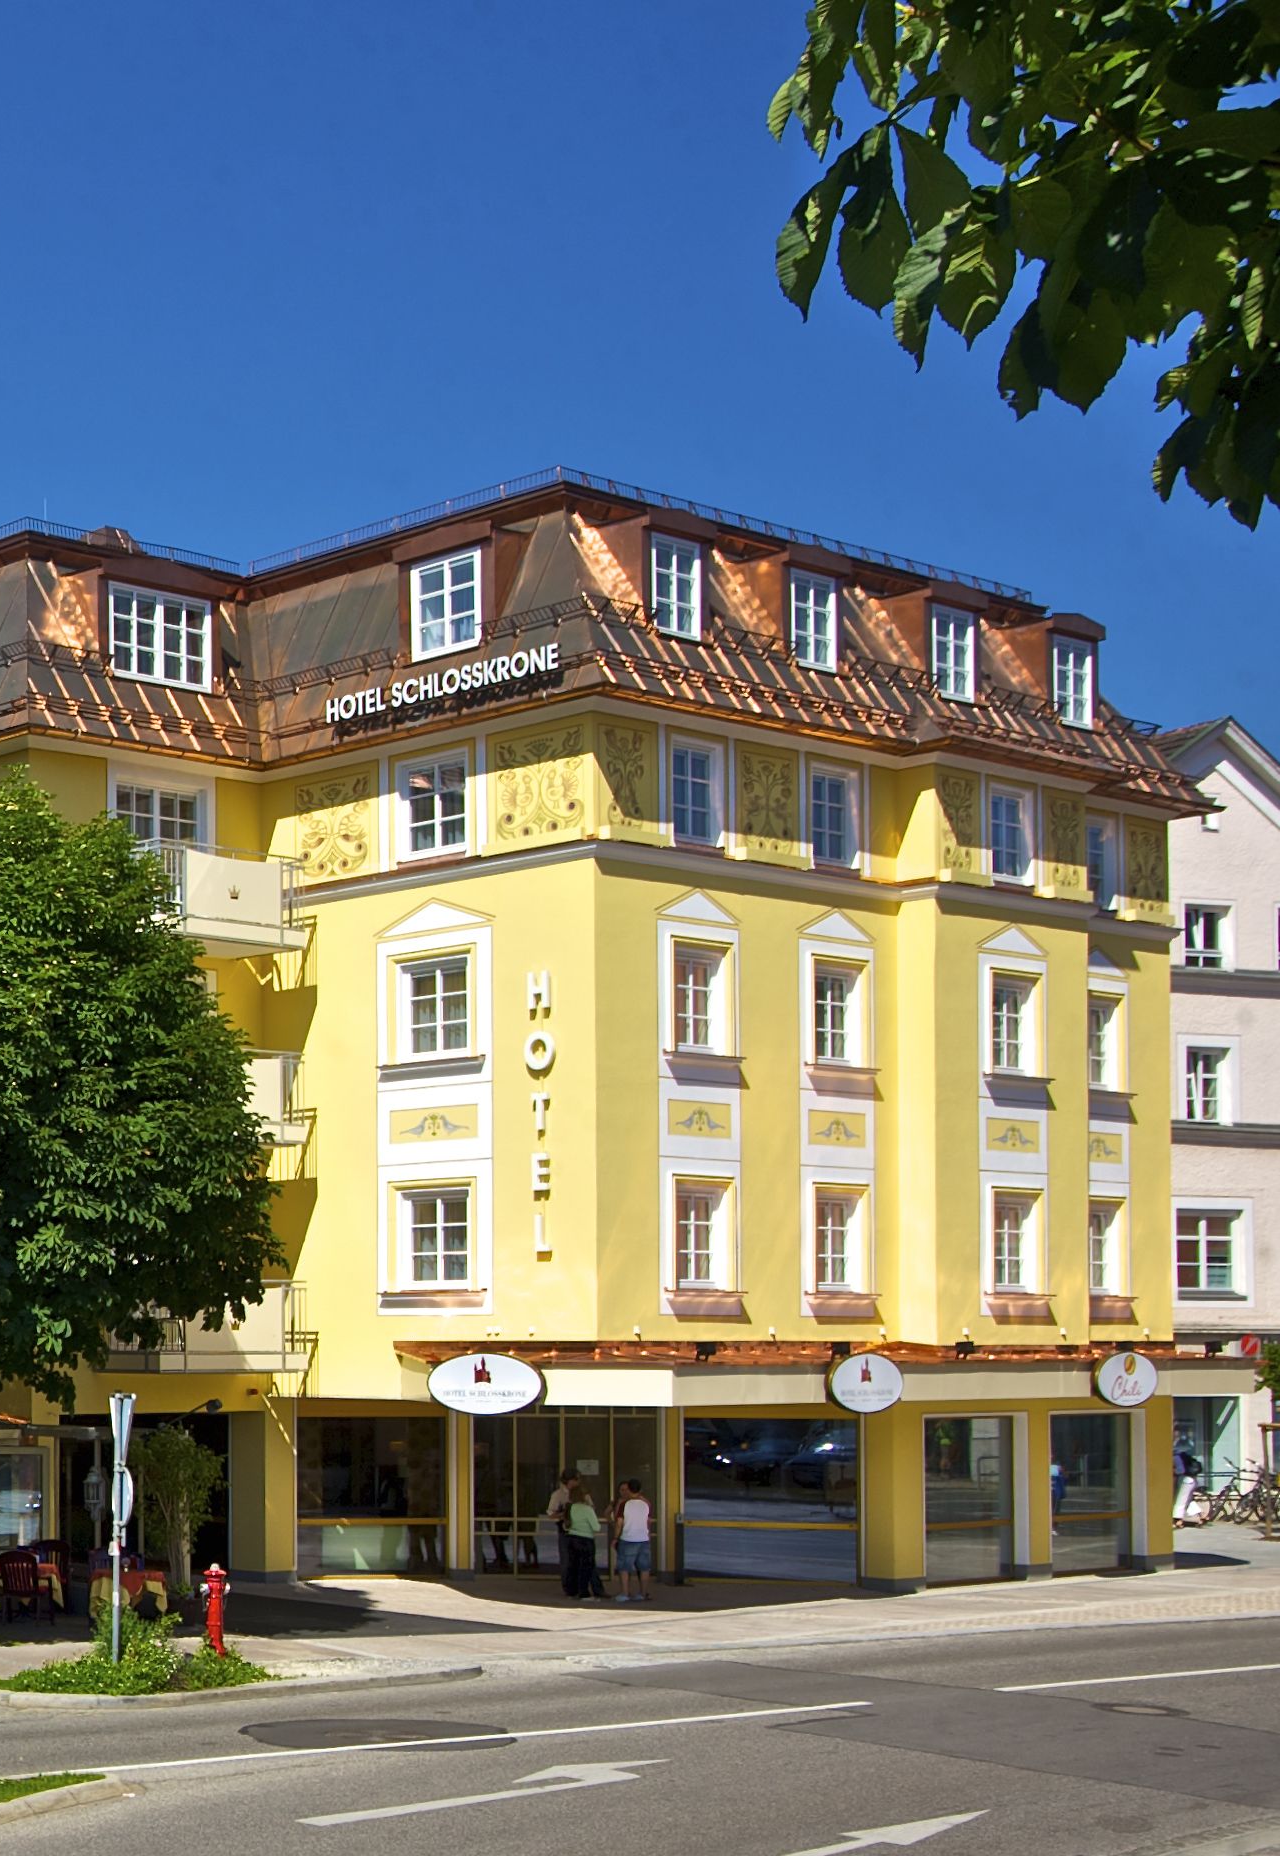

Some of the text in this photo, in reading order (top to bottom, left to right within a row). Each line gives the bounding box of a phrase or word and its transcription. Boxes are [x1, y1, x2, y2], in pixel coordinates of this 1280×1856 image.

[326, 643, 559, 723] HOTEL SCHLOSSKRONE
[524, 970, 555, 1253] HOTEL
